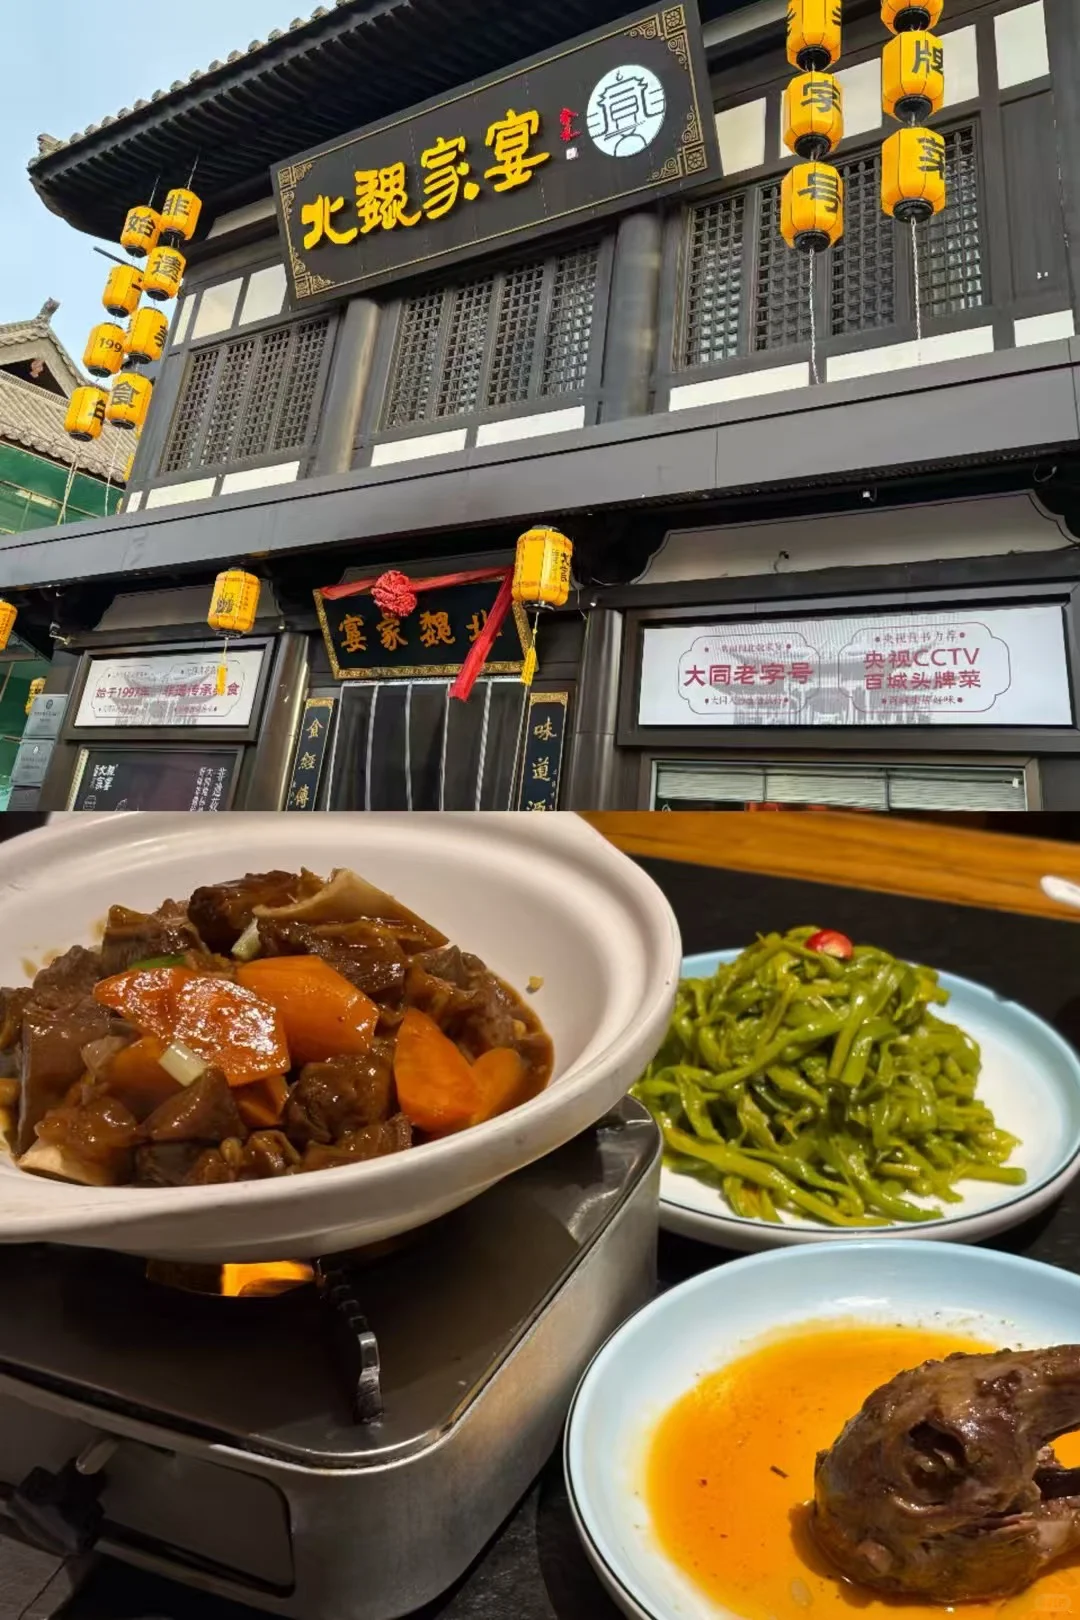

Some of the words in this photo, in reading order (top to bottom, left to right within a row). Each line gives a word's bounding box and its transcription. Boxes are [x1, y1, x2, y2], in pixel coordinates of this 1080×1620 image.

[302, 109, 550, 249] 北魏家宴
[864, 648, 980, 669] 央视CCTV
[684, 662, 814, 687] 大同老字号
[163, 682, 240, 697] 非遗传承食
